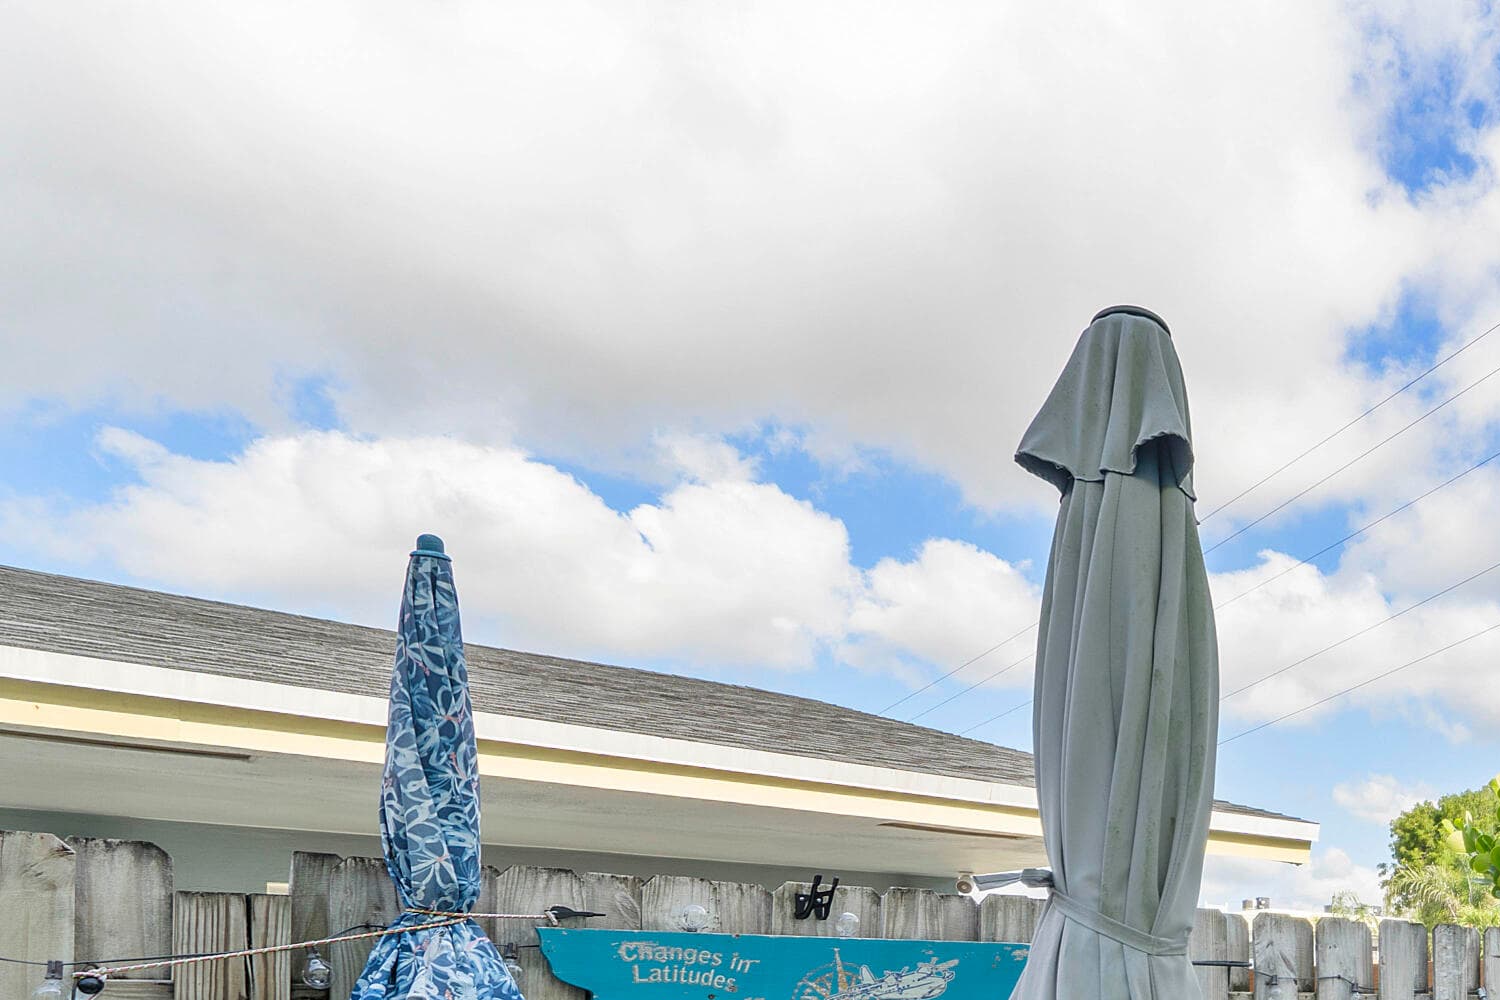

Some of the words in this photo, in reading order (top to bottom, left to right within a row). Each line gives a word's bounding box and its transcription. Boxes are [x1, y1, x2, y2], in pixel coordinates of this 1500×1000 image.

[618, 941, 723, 966] Changes
[730, 952, 760, 973] in
[632, 964, 738, 992] Latitudes
